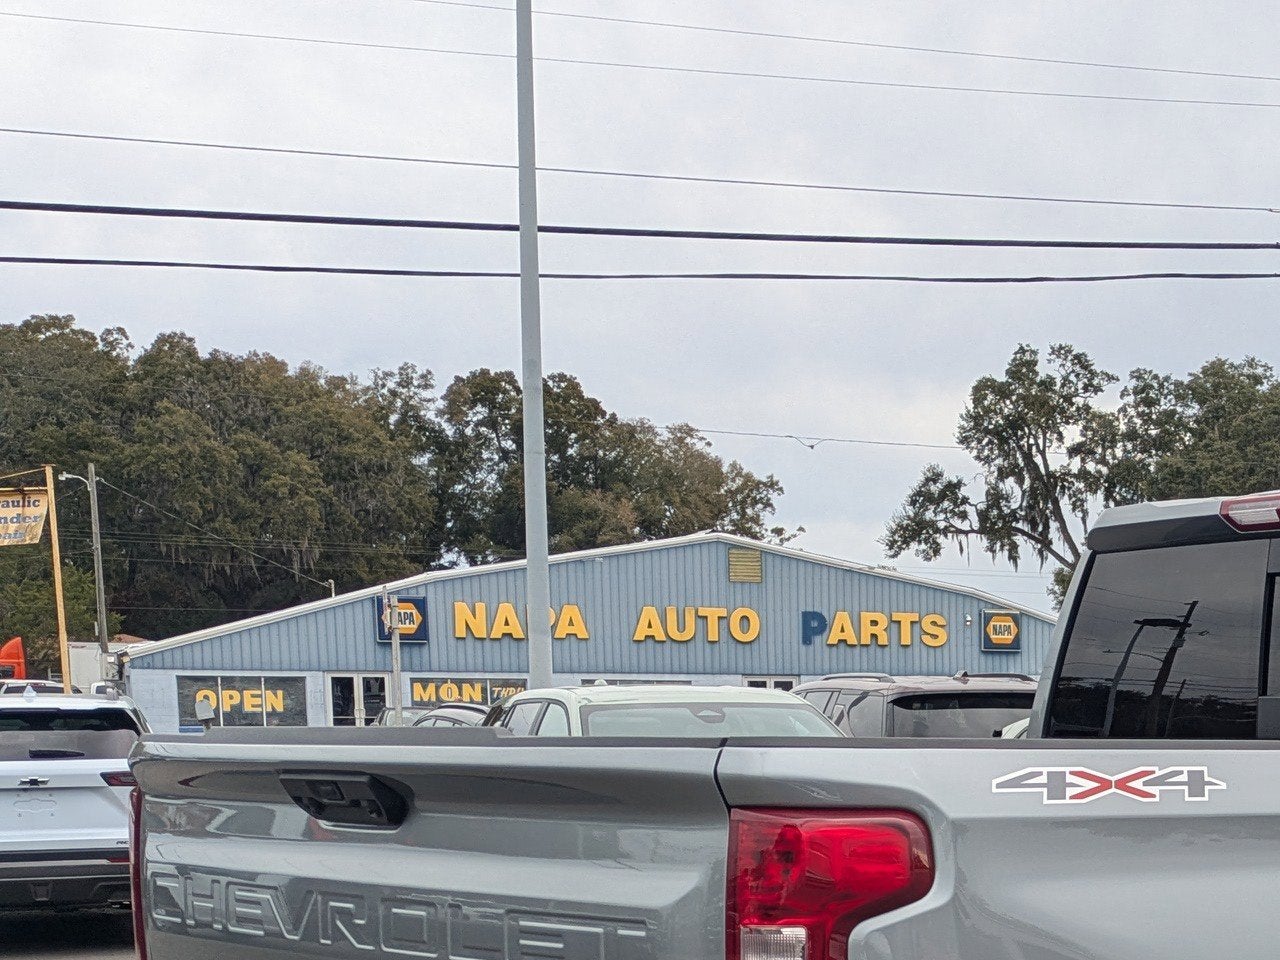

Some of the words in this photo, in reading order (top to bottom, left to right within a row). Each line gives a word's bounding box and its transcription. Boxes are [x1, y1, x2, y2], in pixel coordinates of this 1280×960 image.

[390, 611, 416, 625] APA
[454, 602, 589, 640] NAA
[633, 606, 761, 642] AUTO
[801, 610, 948, 647] PARTS
[992, 624, 1012, 636] NAPA
[195, 689, 285, 712] OPEN
[413, 682, 483, 702] MON
[492, 686, 526, 699] THR
